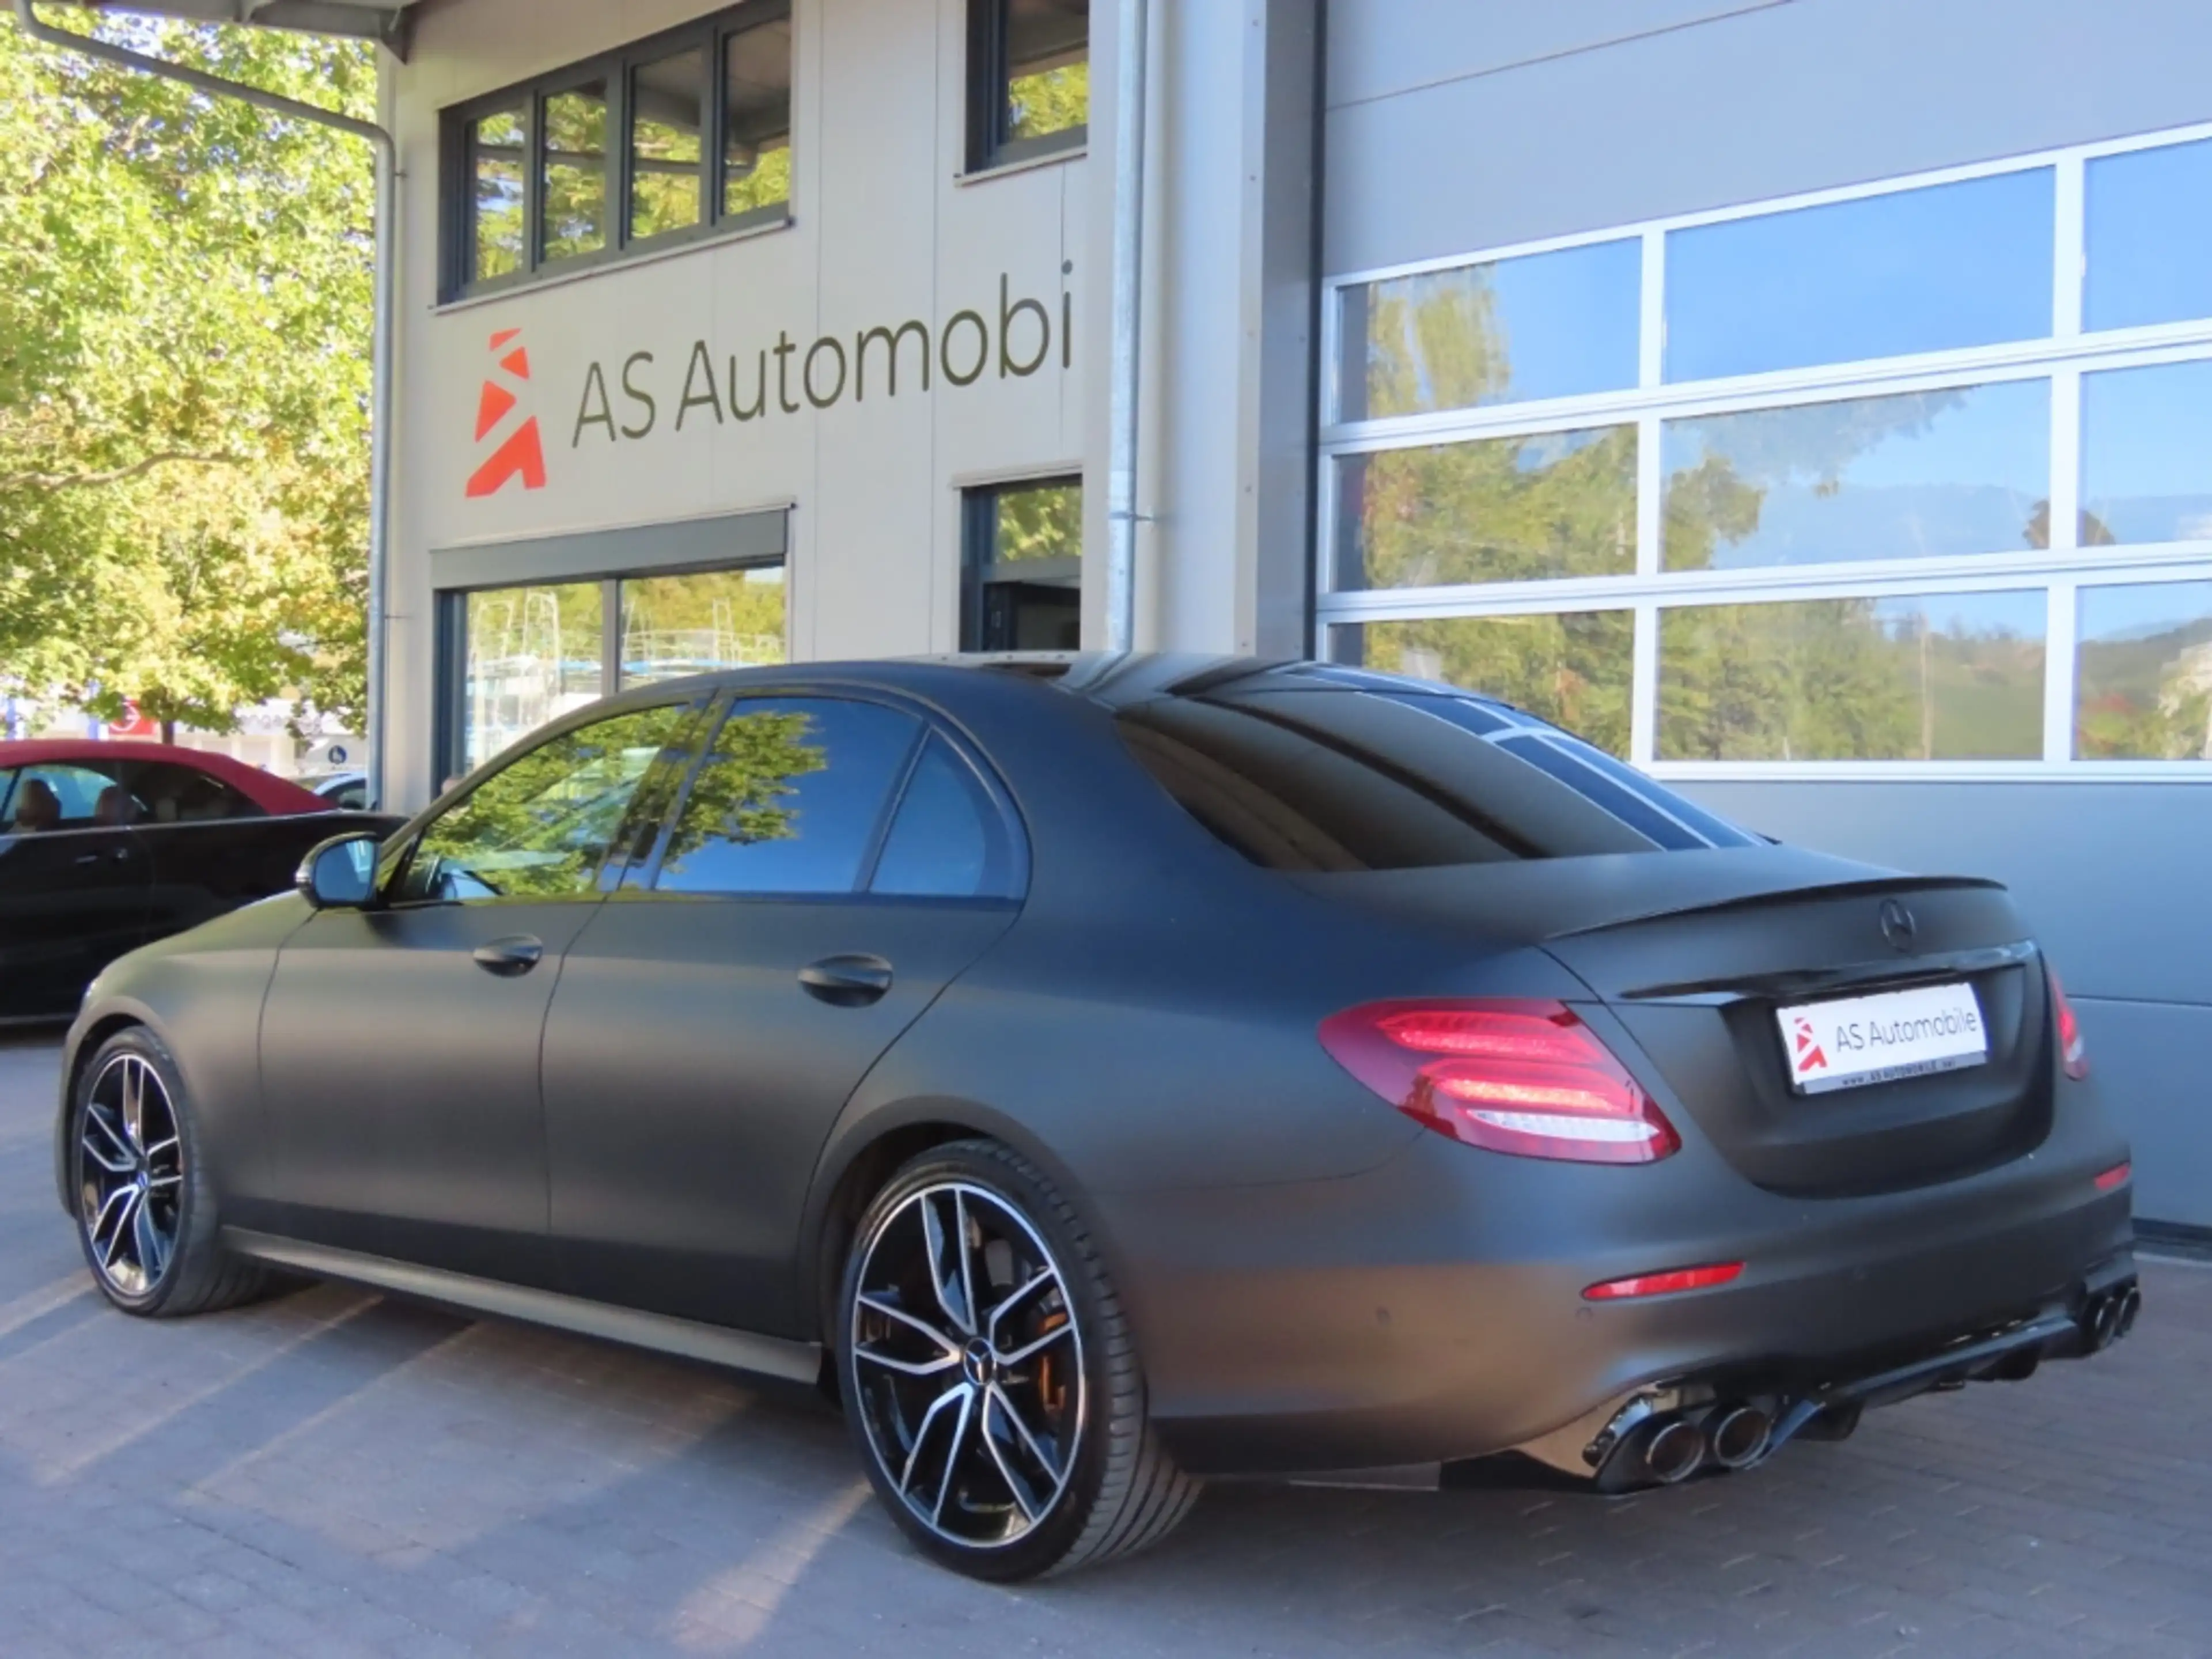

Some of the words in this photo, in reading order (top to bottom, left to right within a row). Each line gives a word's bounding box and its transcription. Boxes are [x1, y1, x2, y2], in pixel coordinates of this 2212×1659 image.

[571, 350, 656, 449] AS
[1836, 1023, 1865, 1052] AS
[1870, 1007, 1976, 1047] Automobile
